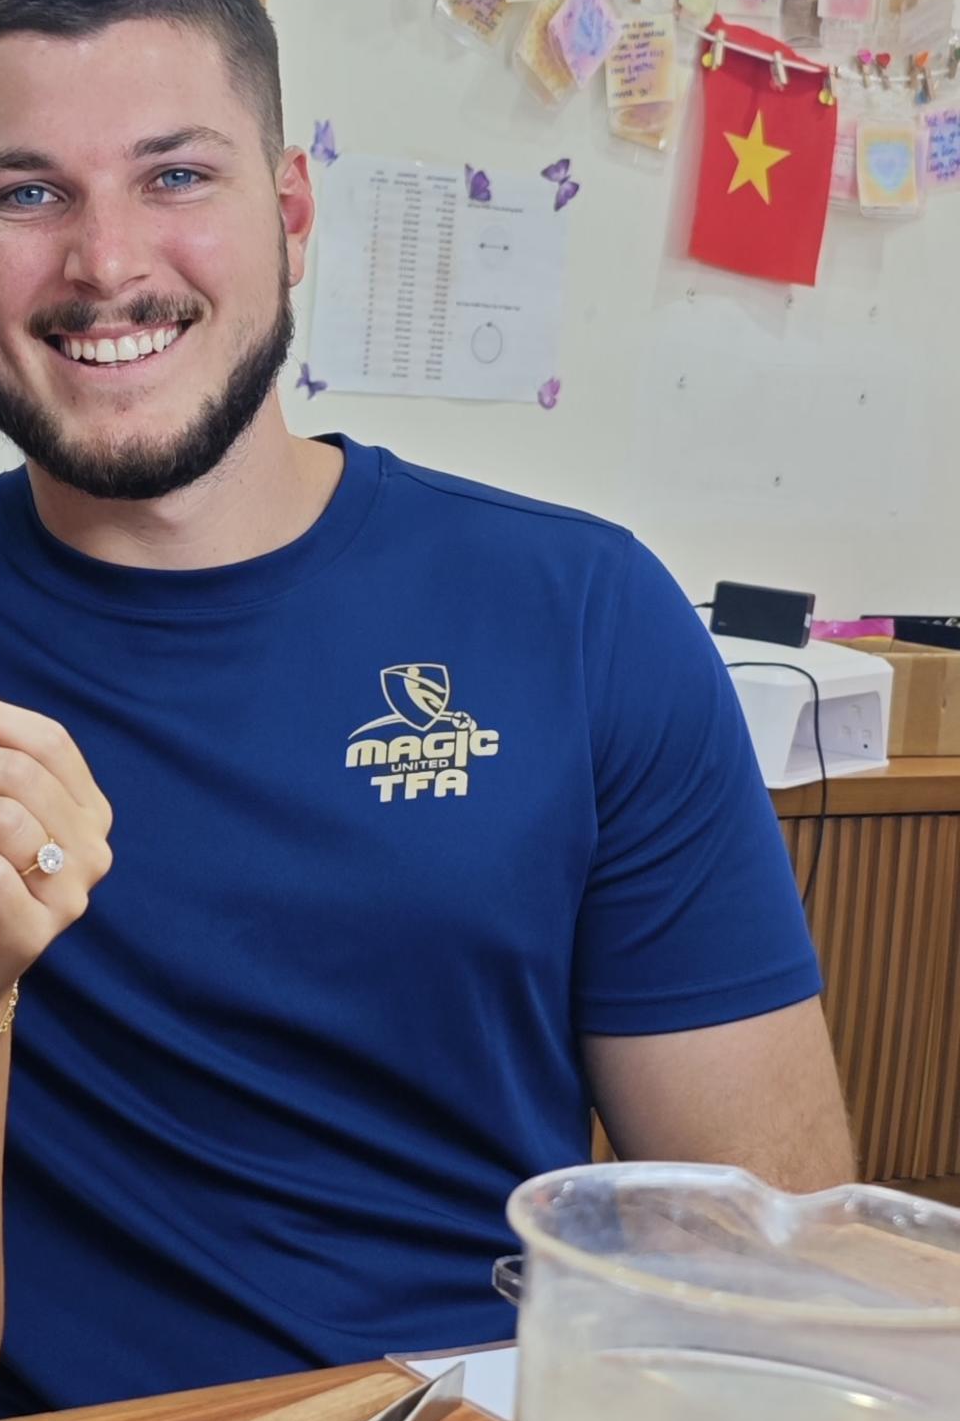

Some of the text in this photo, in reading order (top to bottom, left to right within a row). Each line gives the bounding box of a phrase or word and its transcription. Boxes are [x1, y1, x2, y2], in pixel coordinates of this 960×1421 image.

[345, 729, 500, 768] MAGIC
[390, 759, 450, 773] UNITED
[370, 768, 469, 803] TFA
